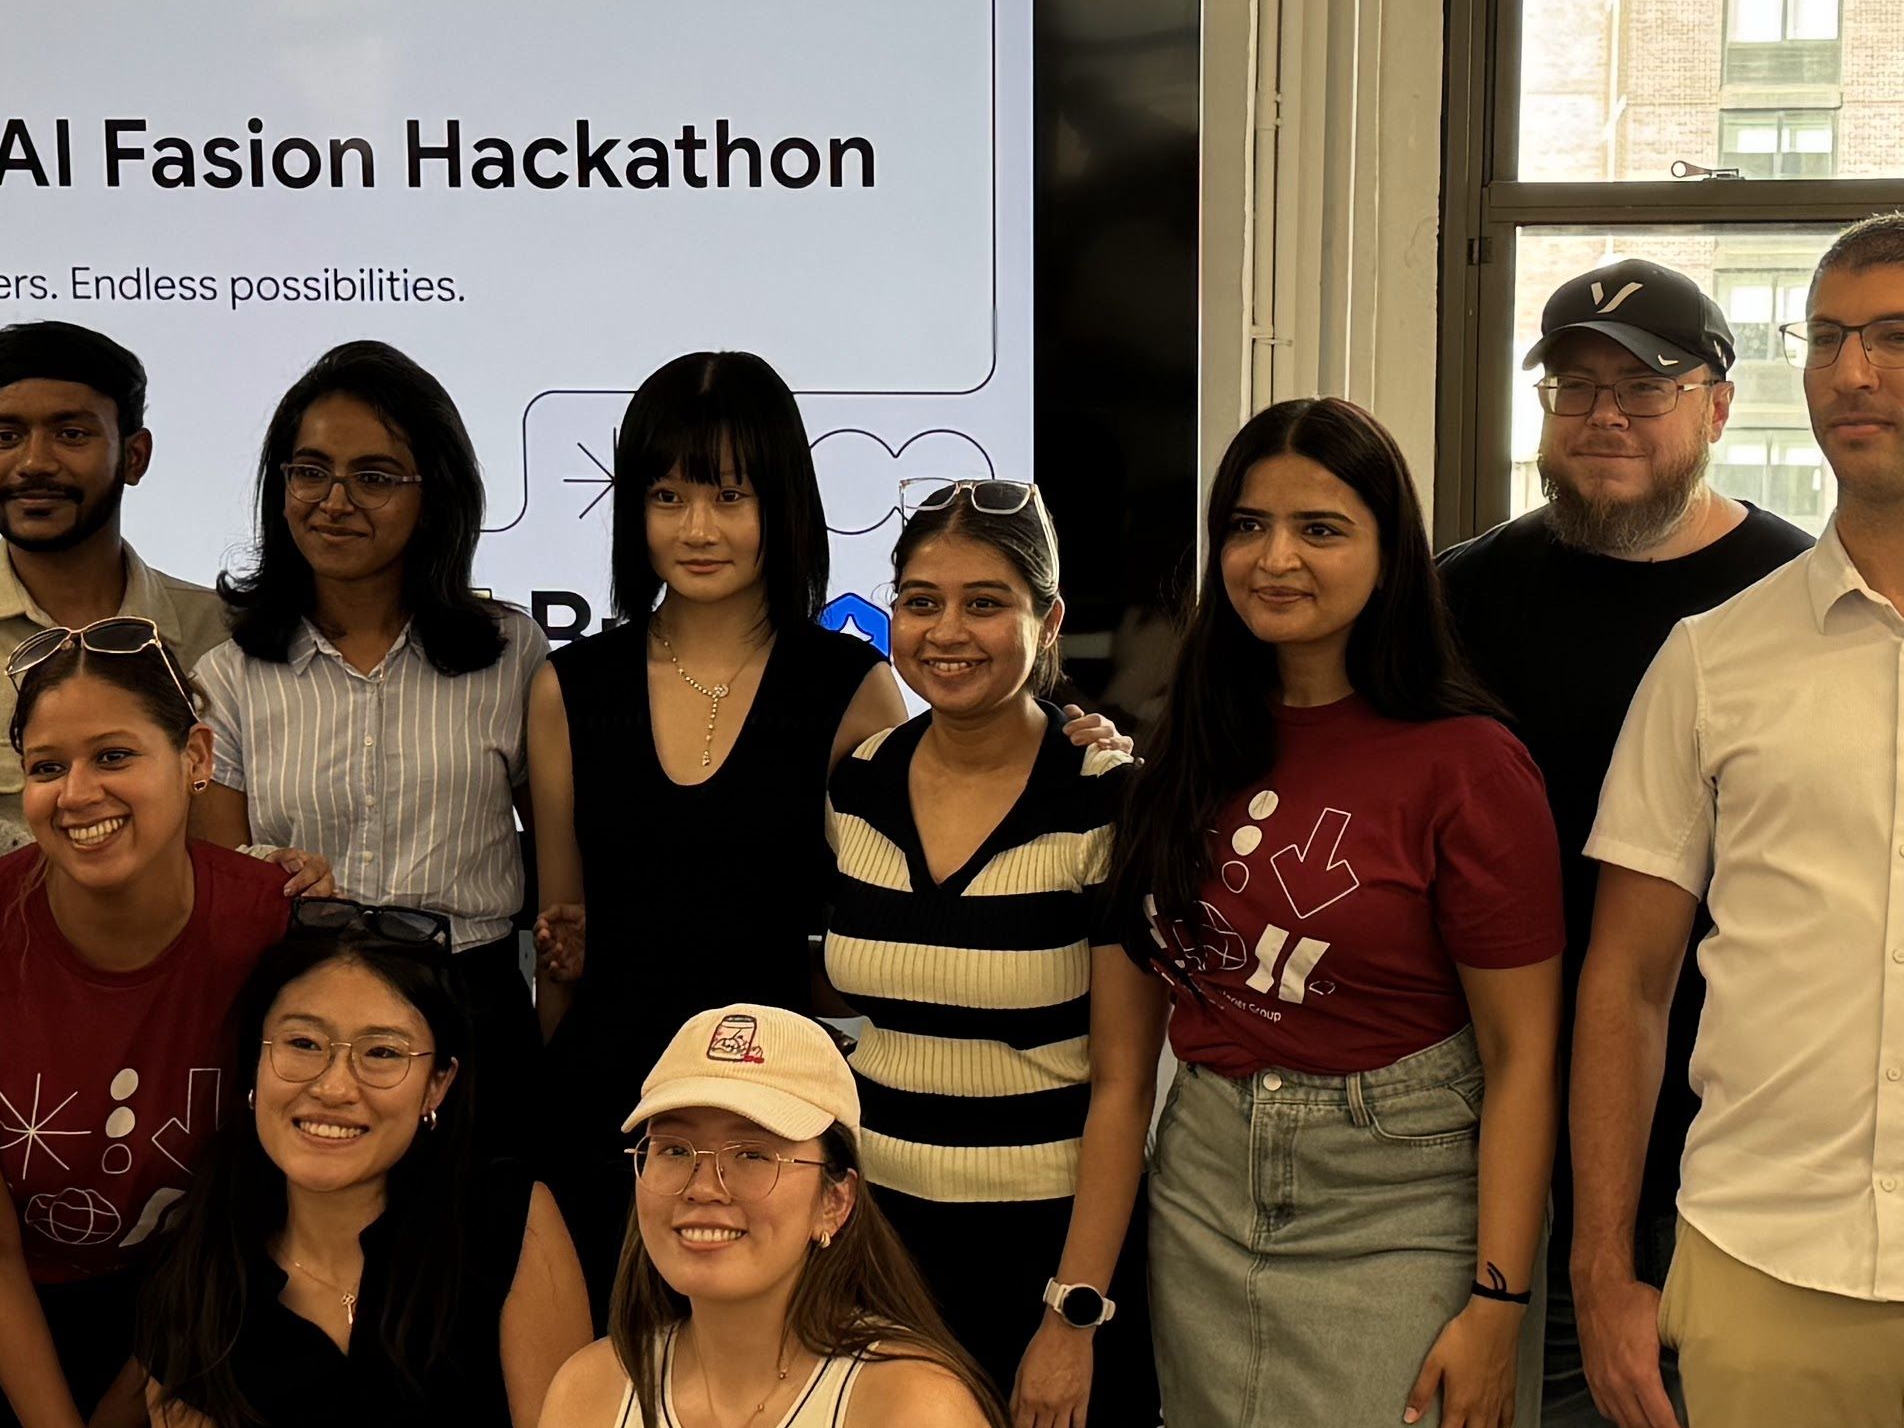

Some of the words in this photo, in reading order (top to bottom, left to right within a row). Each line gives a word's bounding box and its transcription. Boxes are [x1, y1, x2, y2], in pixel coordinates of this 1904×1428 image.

[103, 117, 376, 189] Fasion
[406, 118, 876, 190] Hackathon
[71, 266, 218, 301] Endless
[229, 267, 466, 311] possibilities.
